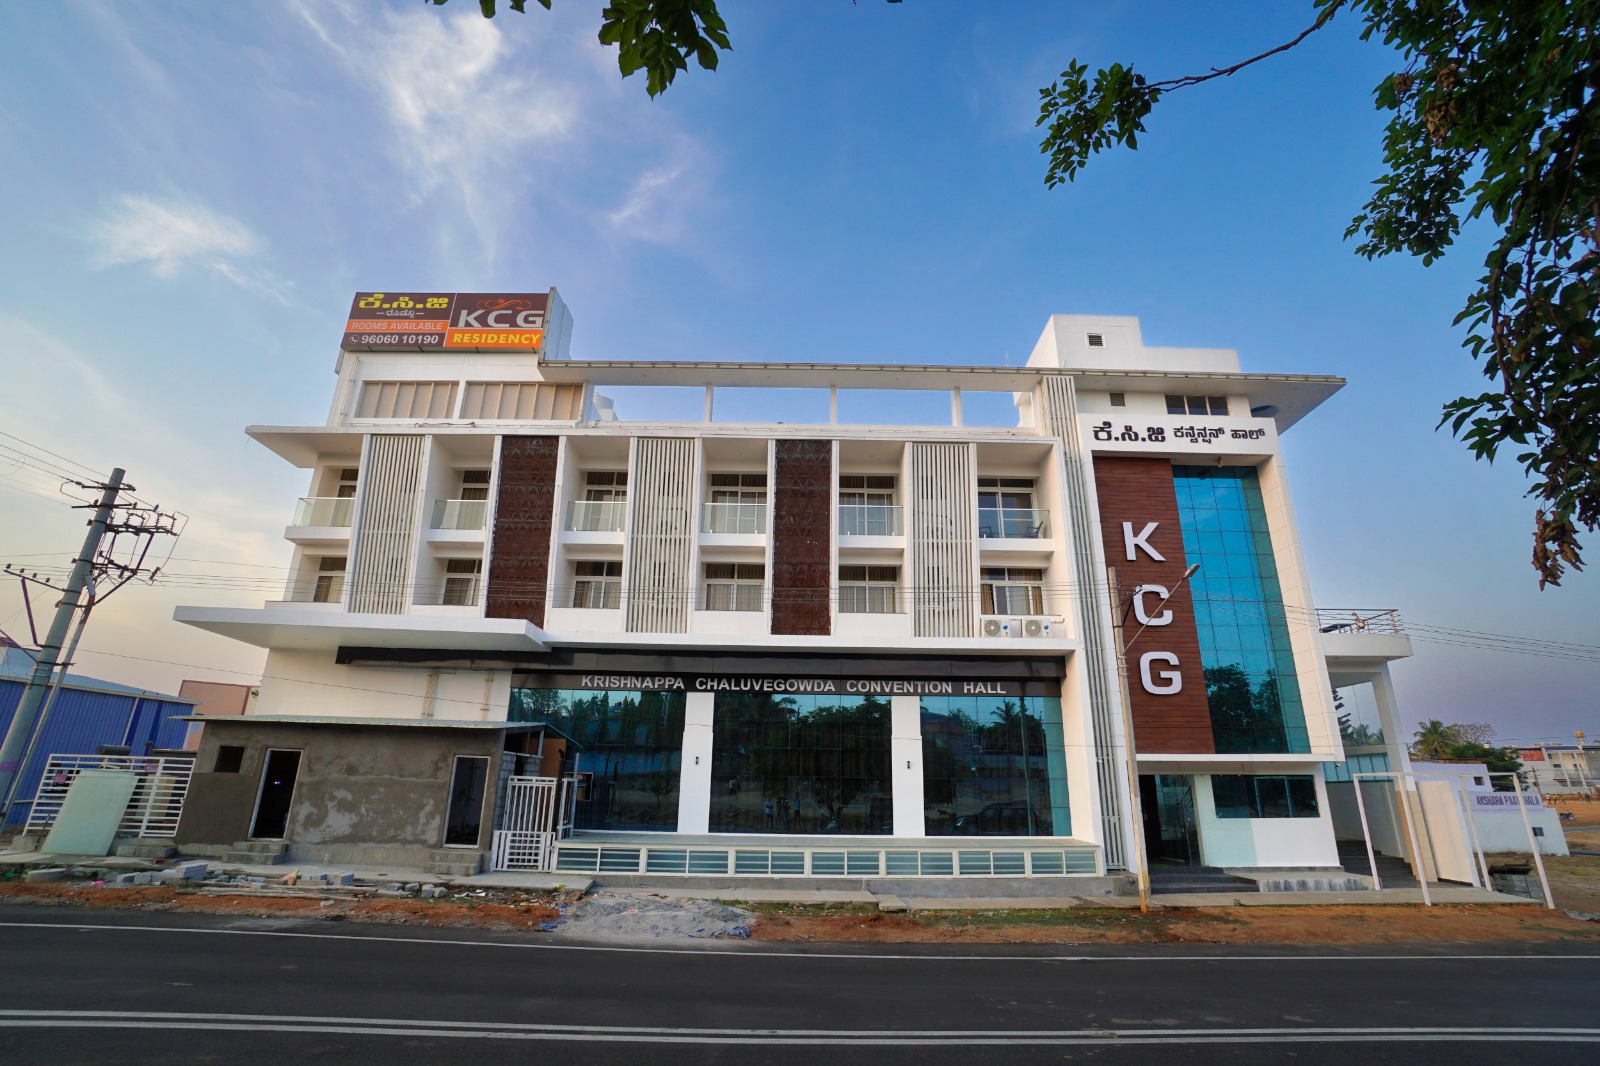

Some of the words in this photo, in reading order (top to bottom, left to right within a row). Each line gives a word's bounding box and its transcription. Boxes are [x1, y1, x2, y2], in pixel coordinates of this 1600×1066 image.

[457, 309, 545, 328] KCG
[351, 322, 388, 330] ROOMS
[390, 322, 443, 330] AVAILABLE
[361, 335, 399, 344] 96060
[402, 335, 439, 344] 10190
[452, 333, 541, 344] RESIDENCY
[581, 675, 685, 690] KRISHNAPPA
[695, 677, 836, 692] CHALUVEGOWDA
[846, 680, 953, 694] CONVENTION
[963, 681, 1007, 695] HALL
[1504, 795, 1541, 806] PAATHALA
